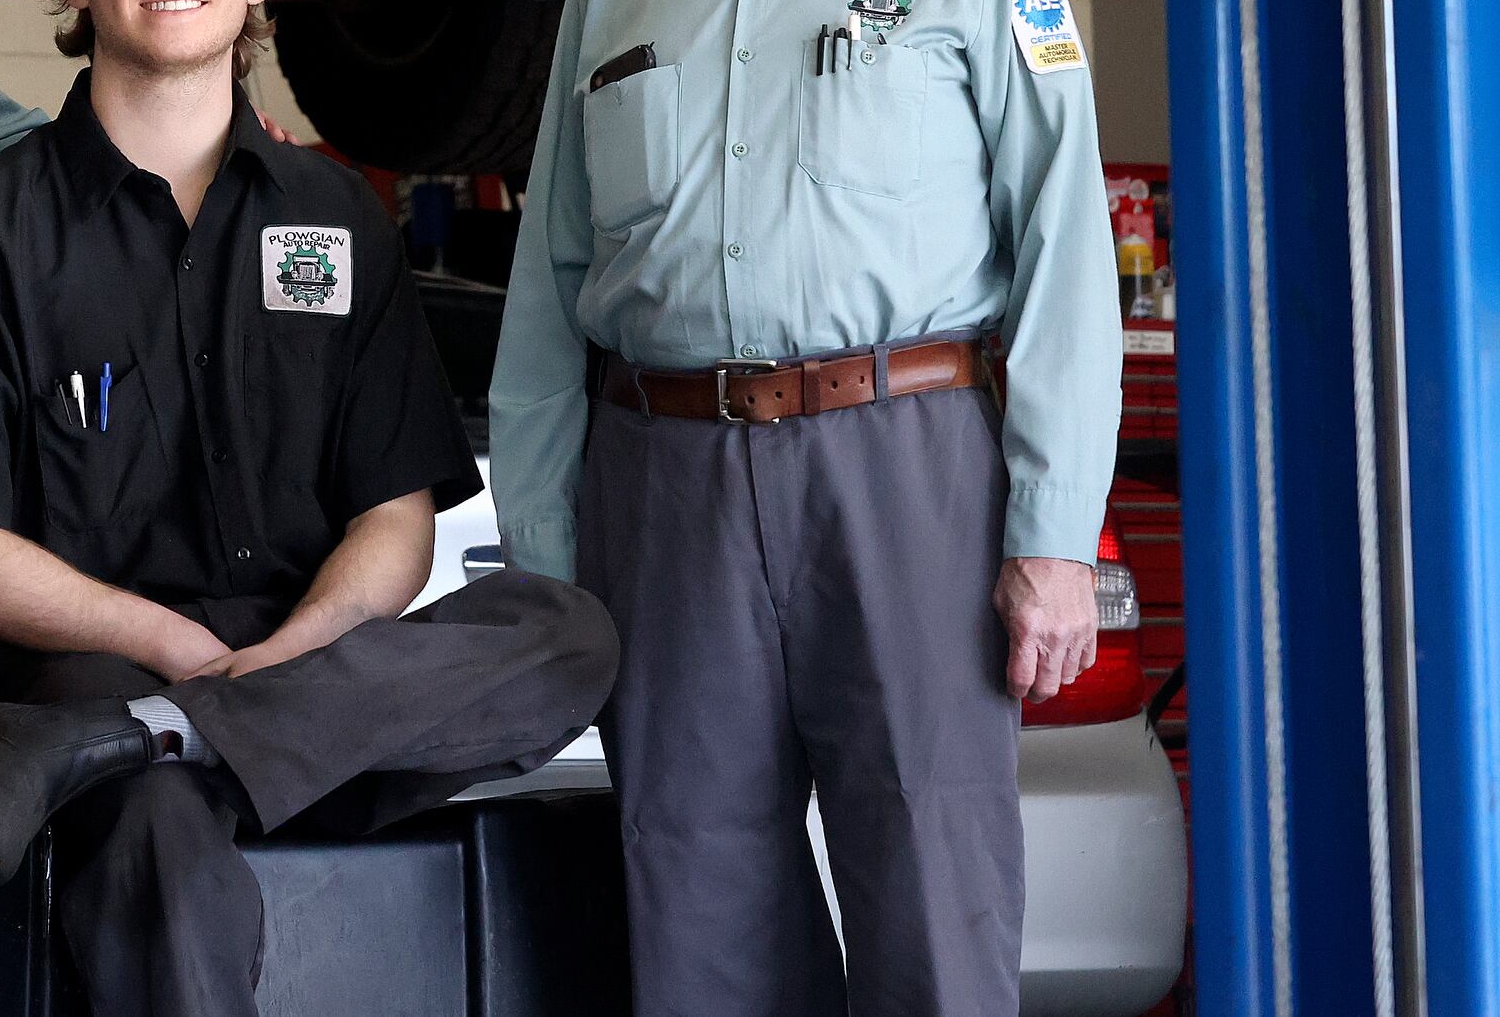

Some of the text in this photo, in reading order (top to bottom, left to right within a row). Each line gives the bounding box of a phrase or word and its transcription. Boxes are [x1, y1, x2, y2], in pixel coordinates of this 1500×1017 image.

[268, 232, 345, 247] PLOWGIAN
[283, 240, 331, 250] AUTO REPAIR
